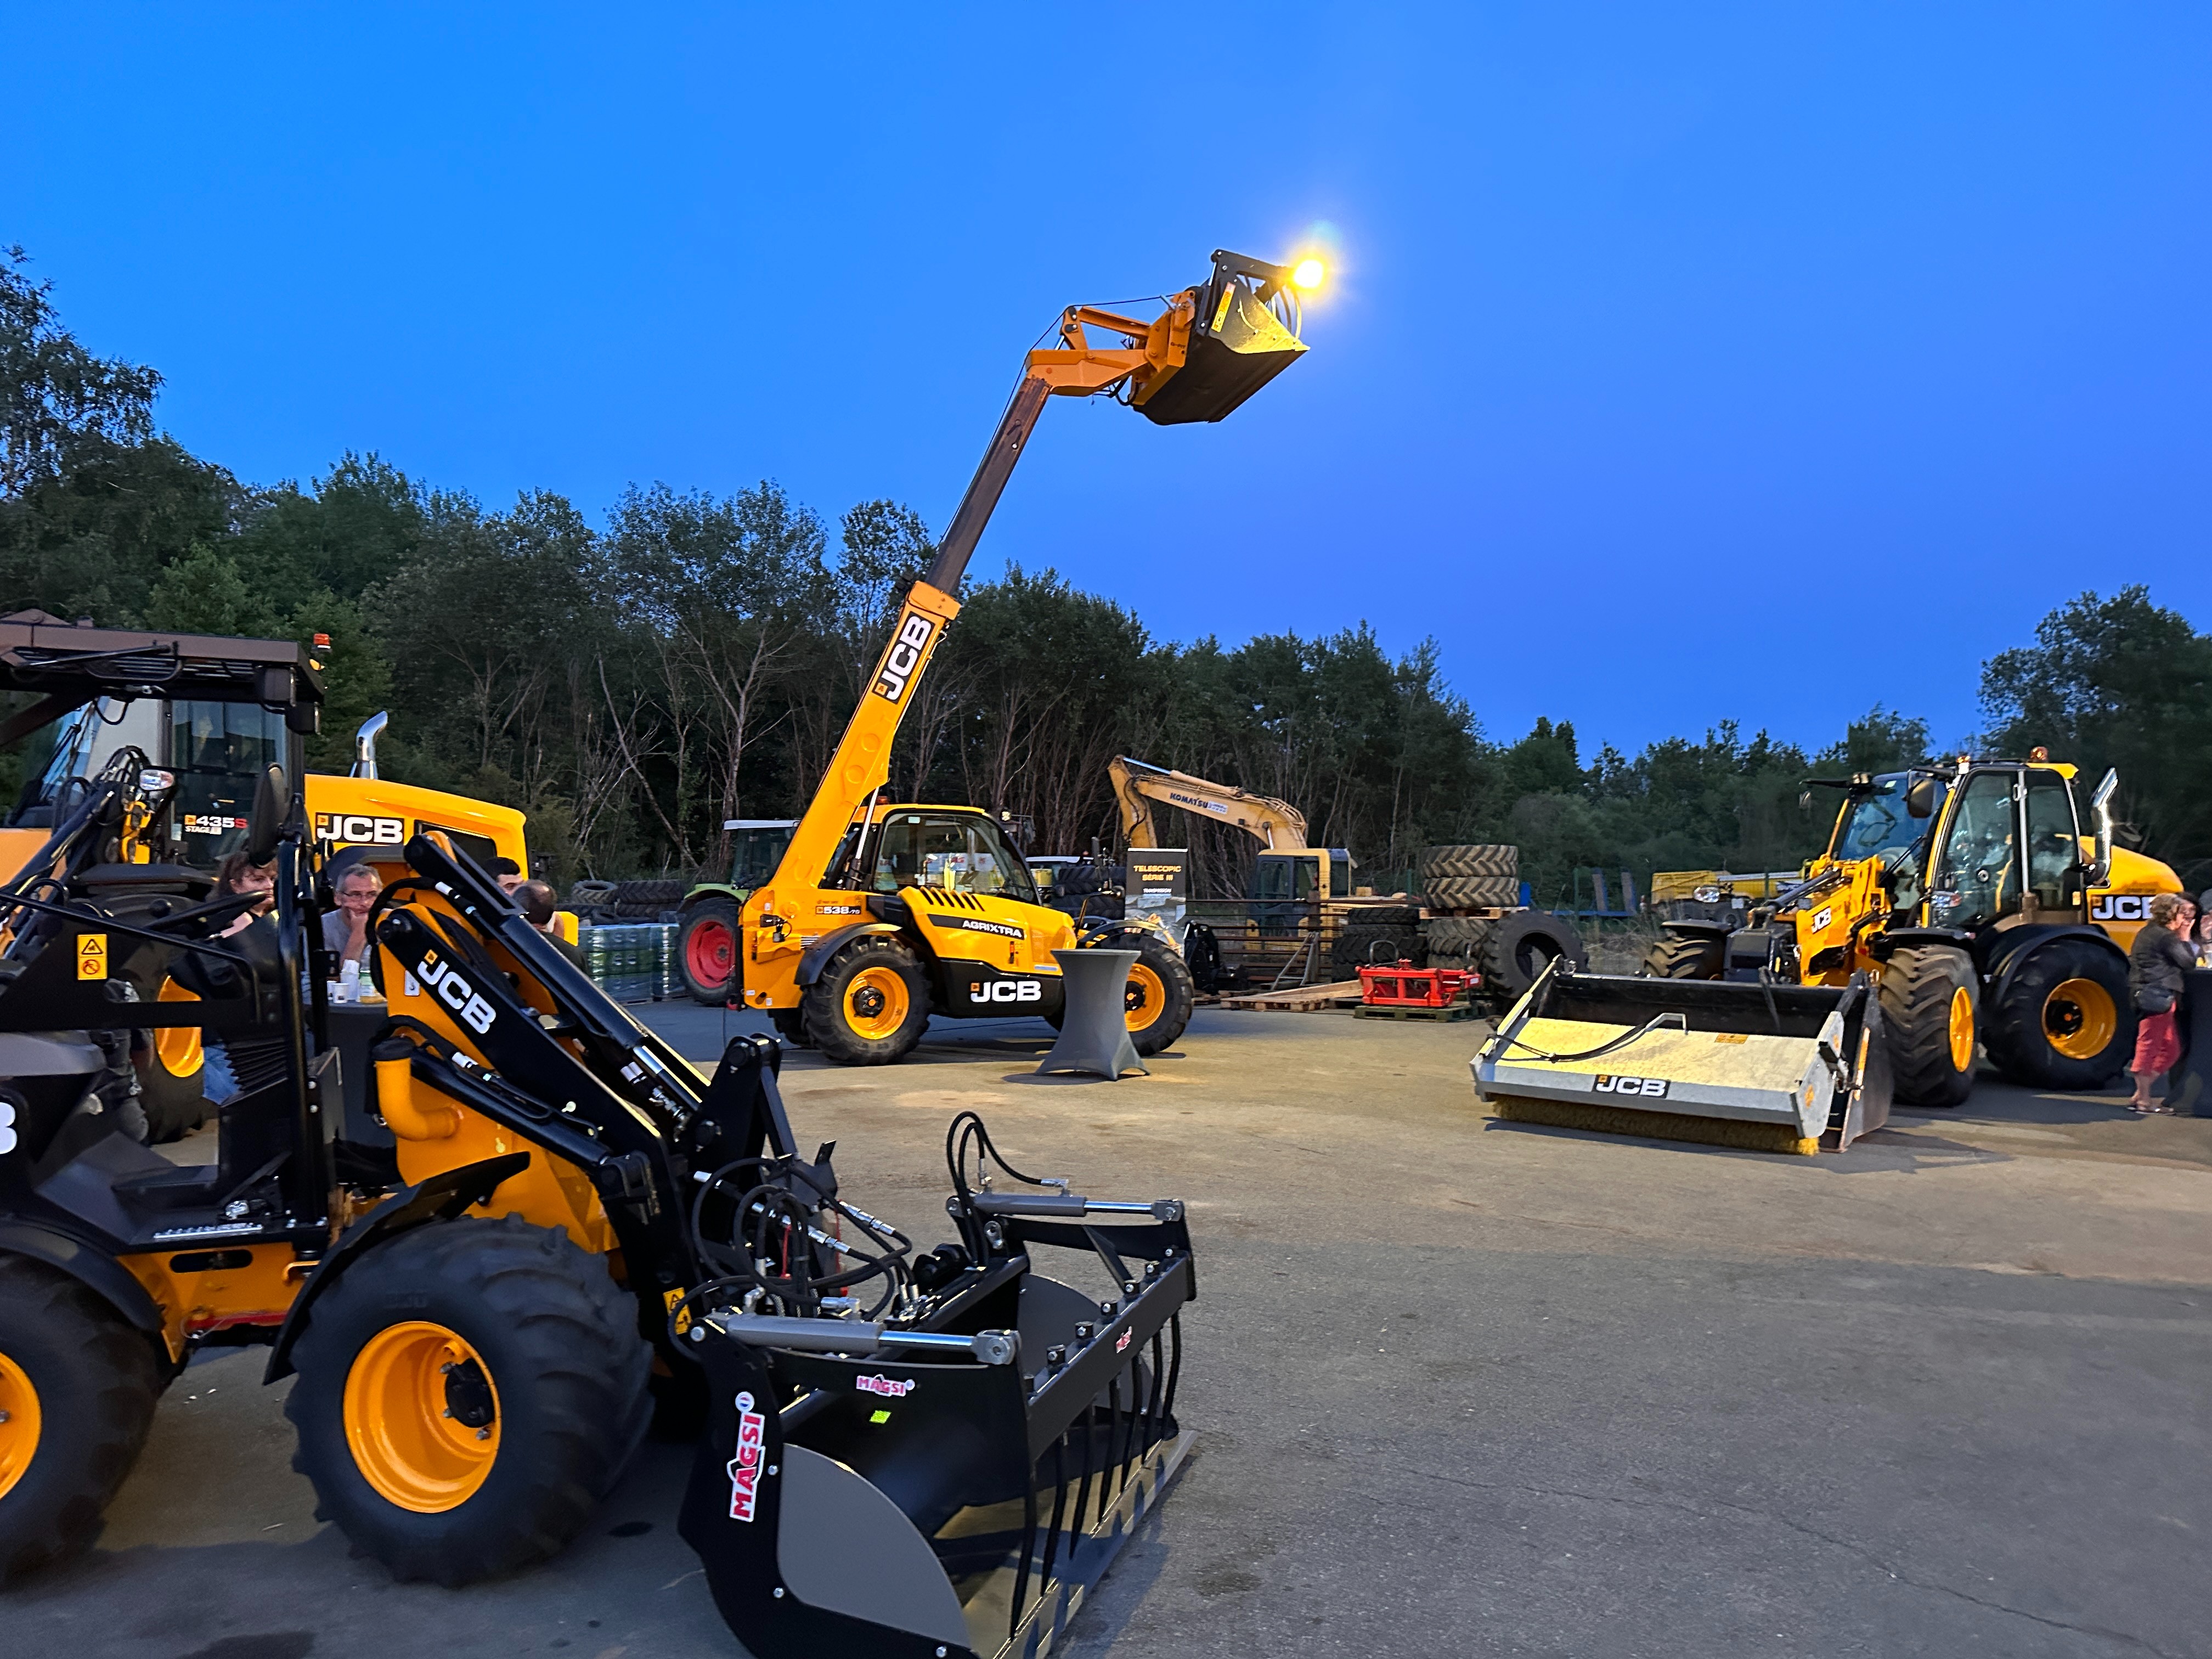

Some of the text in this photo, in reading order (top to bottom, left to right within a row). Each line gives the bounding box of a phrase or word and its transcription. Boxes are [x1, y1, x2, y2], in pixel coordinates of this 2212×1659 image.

[881, 616, 932, 701] JCB
[1170, 792, 1209, 809] KOMATSU
[196, 816, 248, 829] 435S
[317, 815, 403, 844] JCB
[962, 920, 1022, 938] AGRIXTRA
[1811, 907, 1831, 933] JCB
[417, 961, 496, 1034] JCB
[970, 980, 1042, 1003] JCB
[1596, 1076, 1667, 1097] JCB
[858, 1378, 905, 1395] MAGSI
[733, 1413, 761, 1519] MAGSI
